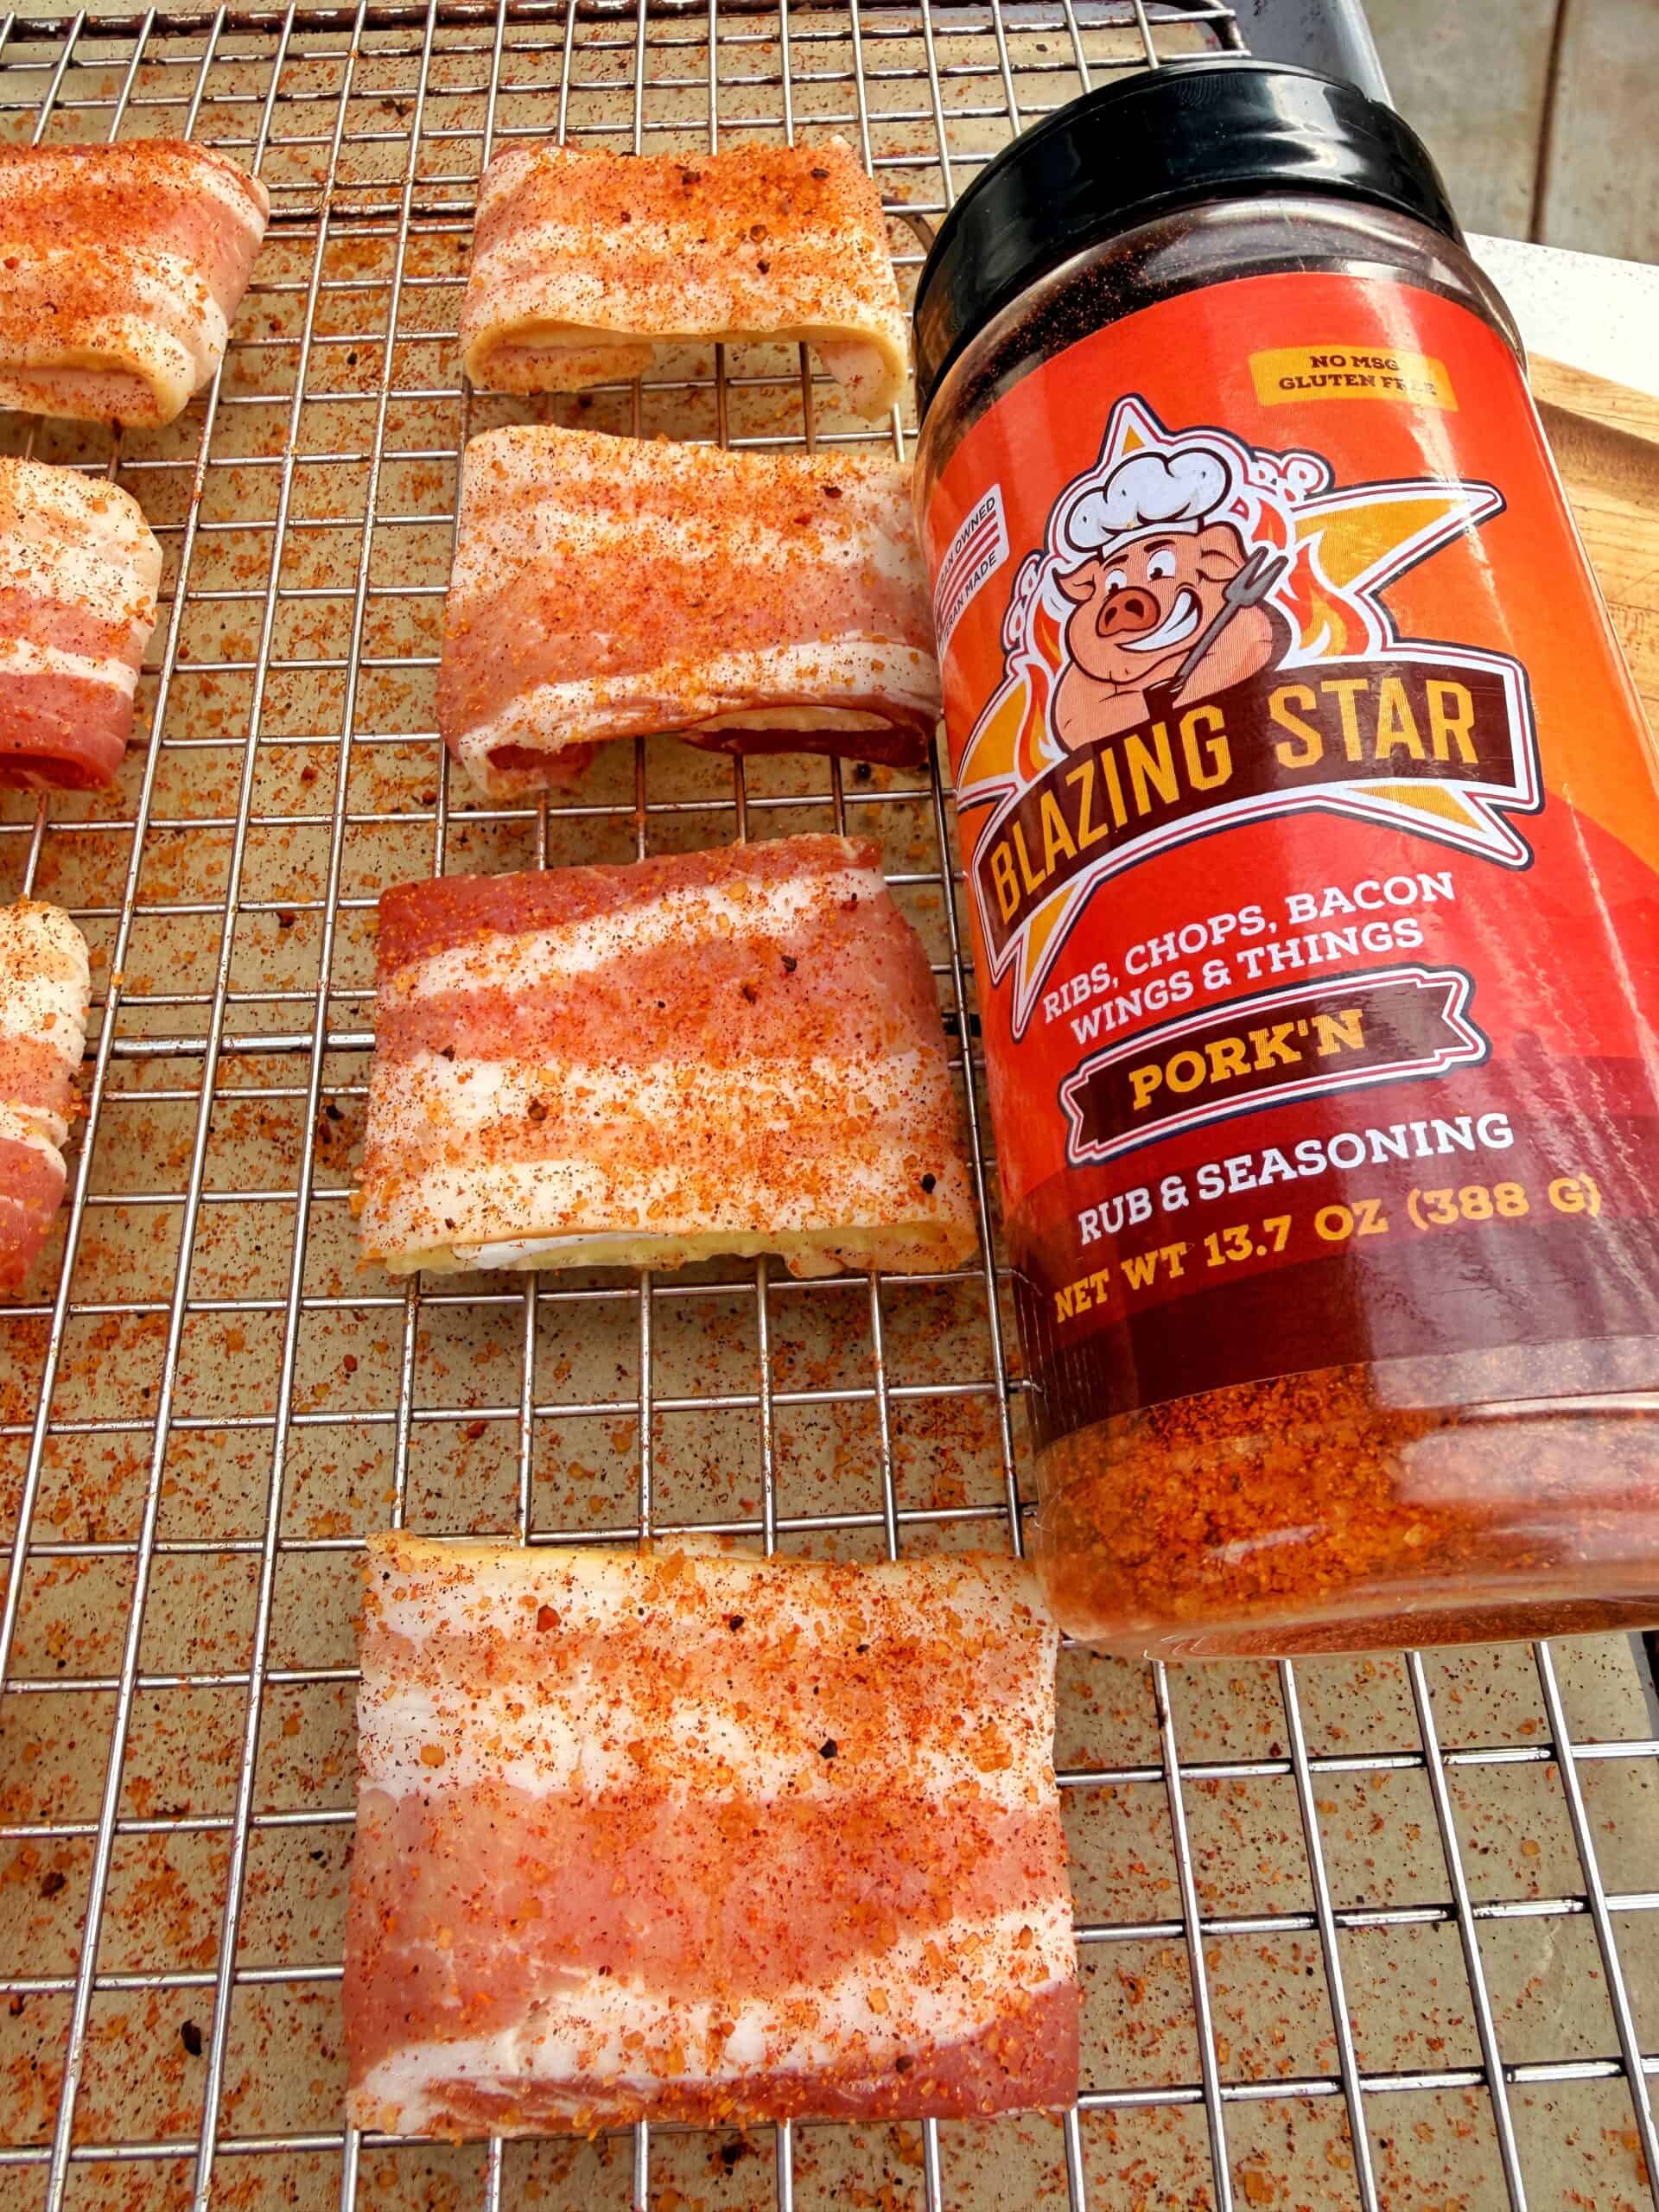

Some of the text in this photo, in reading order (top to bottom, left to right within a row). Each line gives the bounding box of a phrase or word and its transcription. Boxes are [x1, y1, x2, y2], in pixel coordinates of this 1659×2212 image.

[1278, 373, 1376, 391] GLUTEN
[1309, 354, 1401, 372] NO MSG
[956, 497, 995, 553] OWNED
[965, 550, 997, 594] MADE
[991, 677, 1478, 924] BLAZING STAR
[1043, 871, 1456, 1024] RIBS, CHOPS, BACON
[1070, 917, 1424, 1045] WINGS & THINGS
[1129, 1009, 1367, 1111] PORK'N
[1077, 1113, 1515, 1245] RUB & SEASONING
[1054, 1173, 1603, 1323] NET WT 13.7 OZ (388 G)
